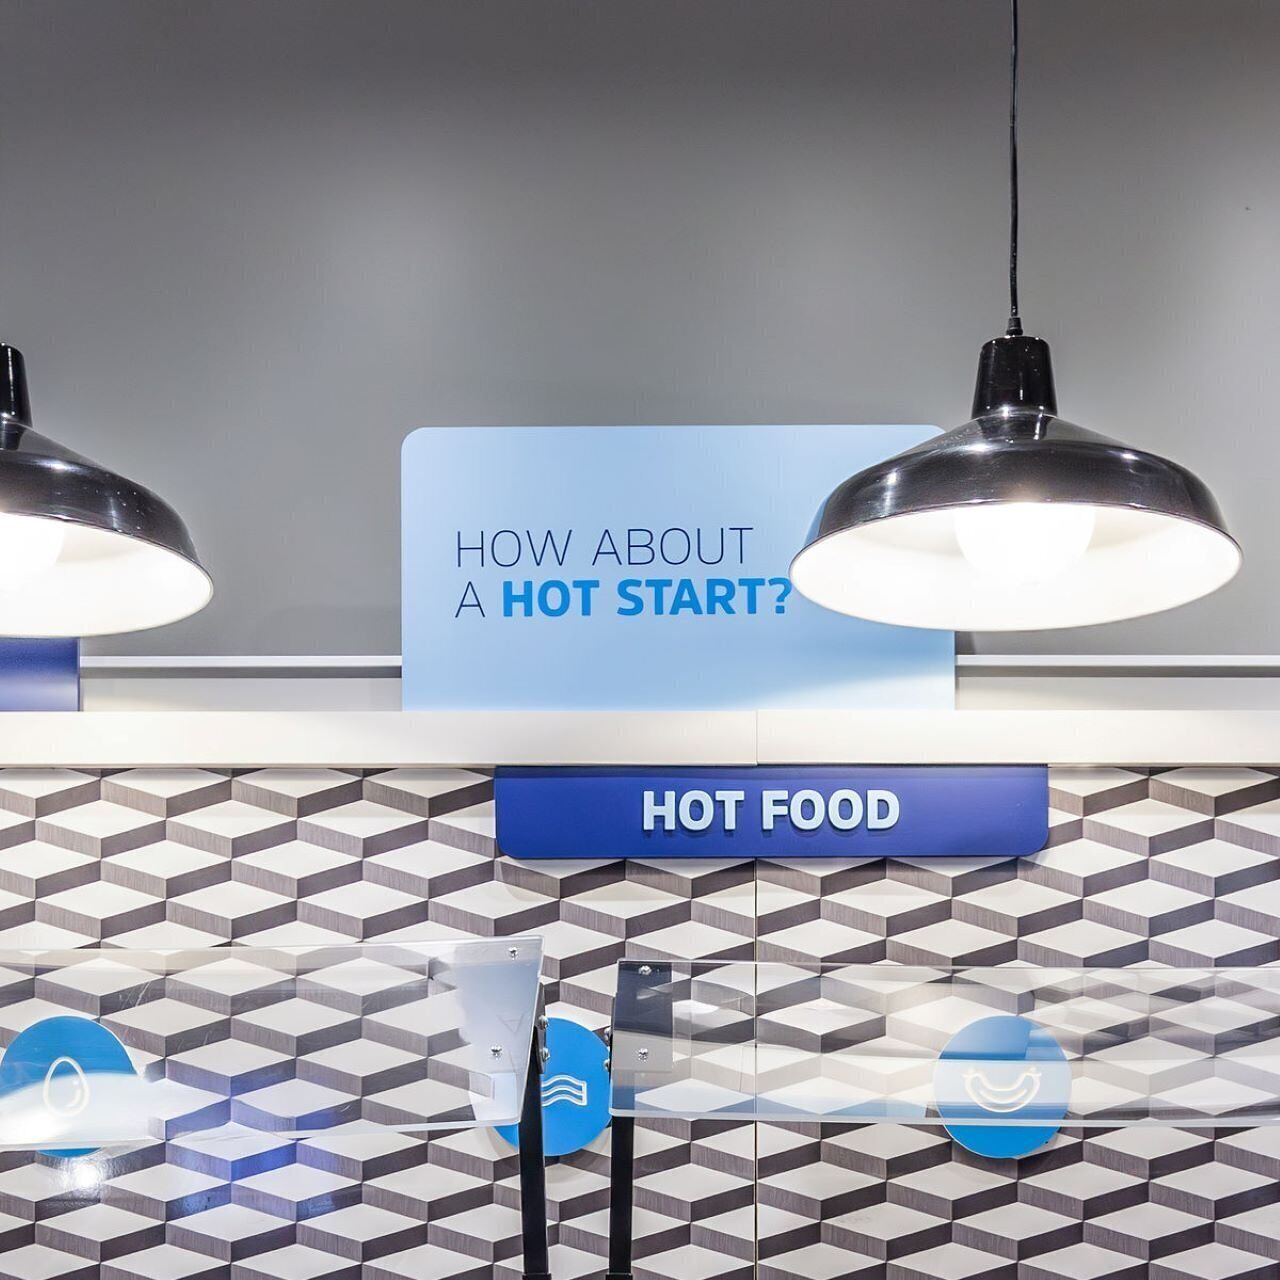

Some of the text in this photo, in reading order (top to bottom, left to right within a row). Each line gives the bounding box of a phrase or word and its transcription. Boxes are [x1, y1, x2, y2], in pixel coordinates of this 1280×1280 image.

[456, 527, 754, 568] HOW ABOUT
[455, 577, 792, 619] A HOT START?
[641, 788, 901, 834] HOT FOOD
